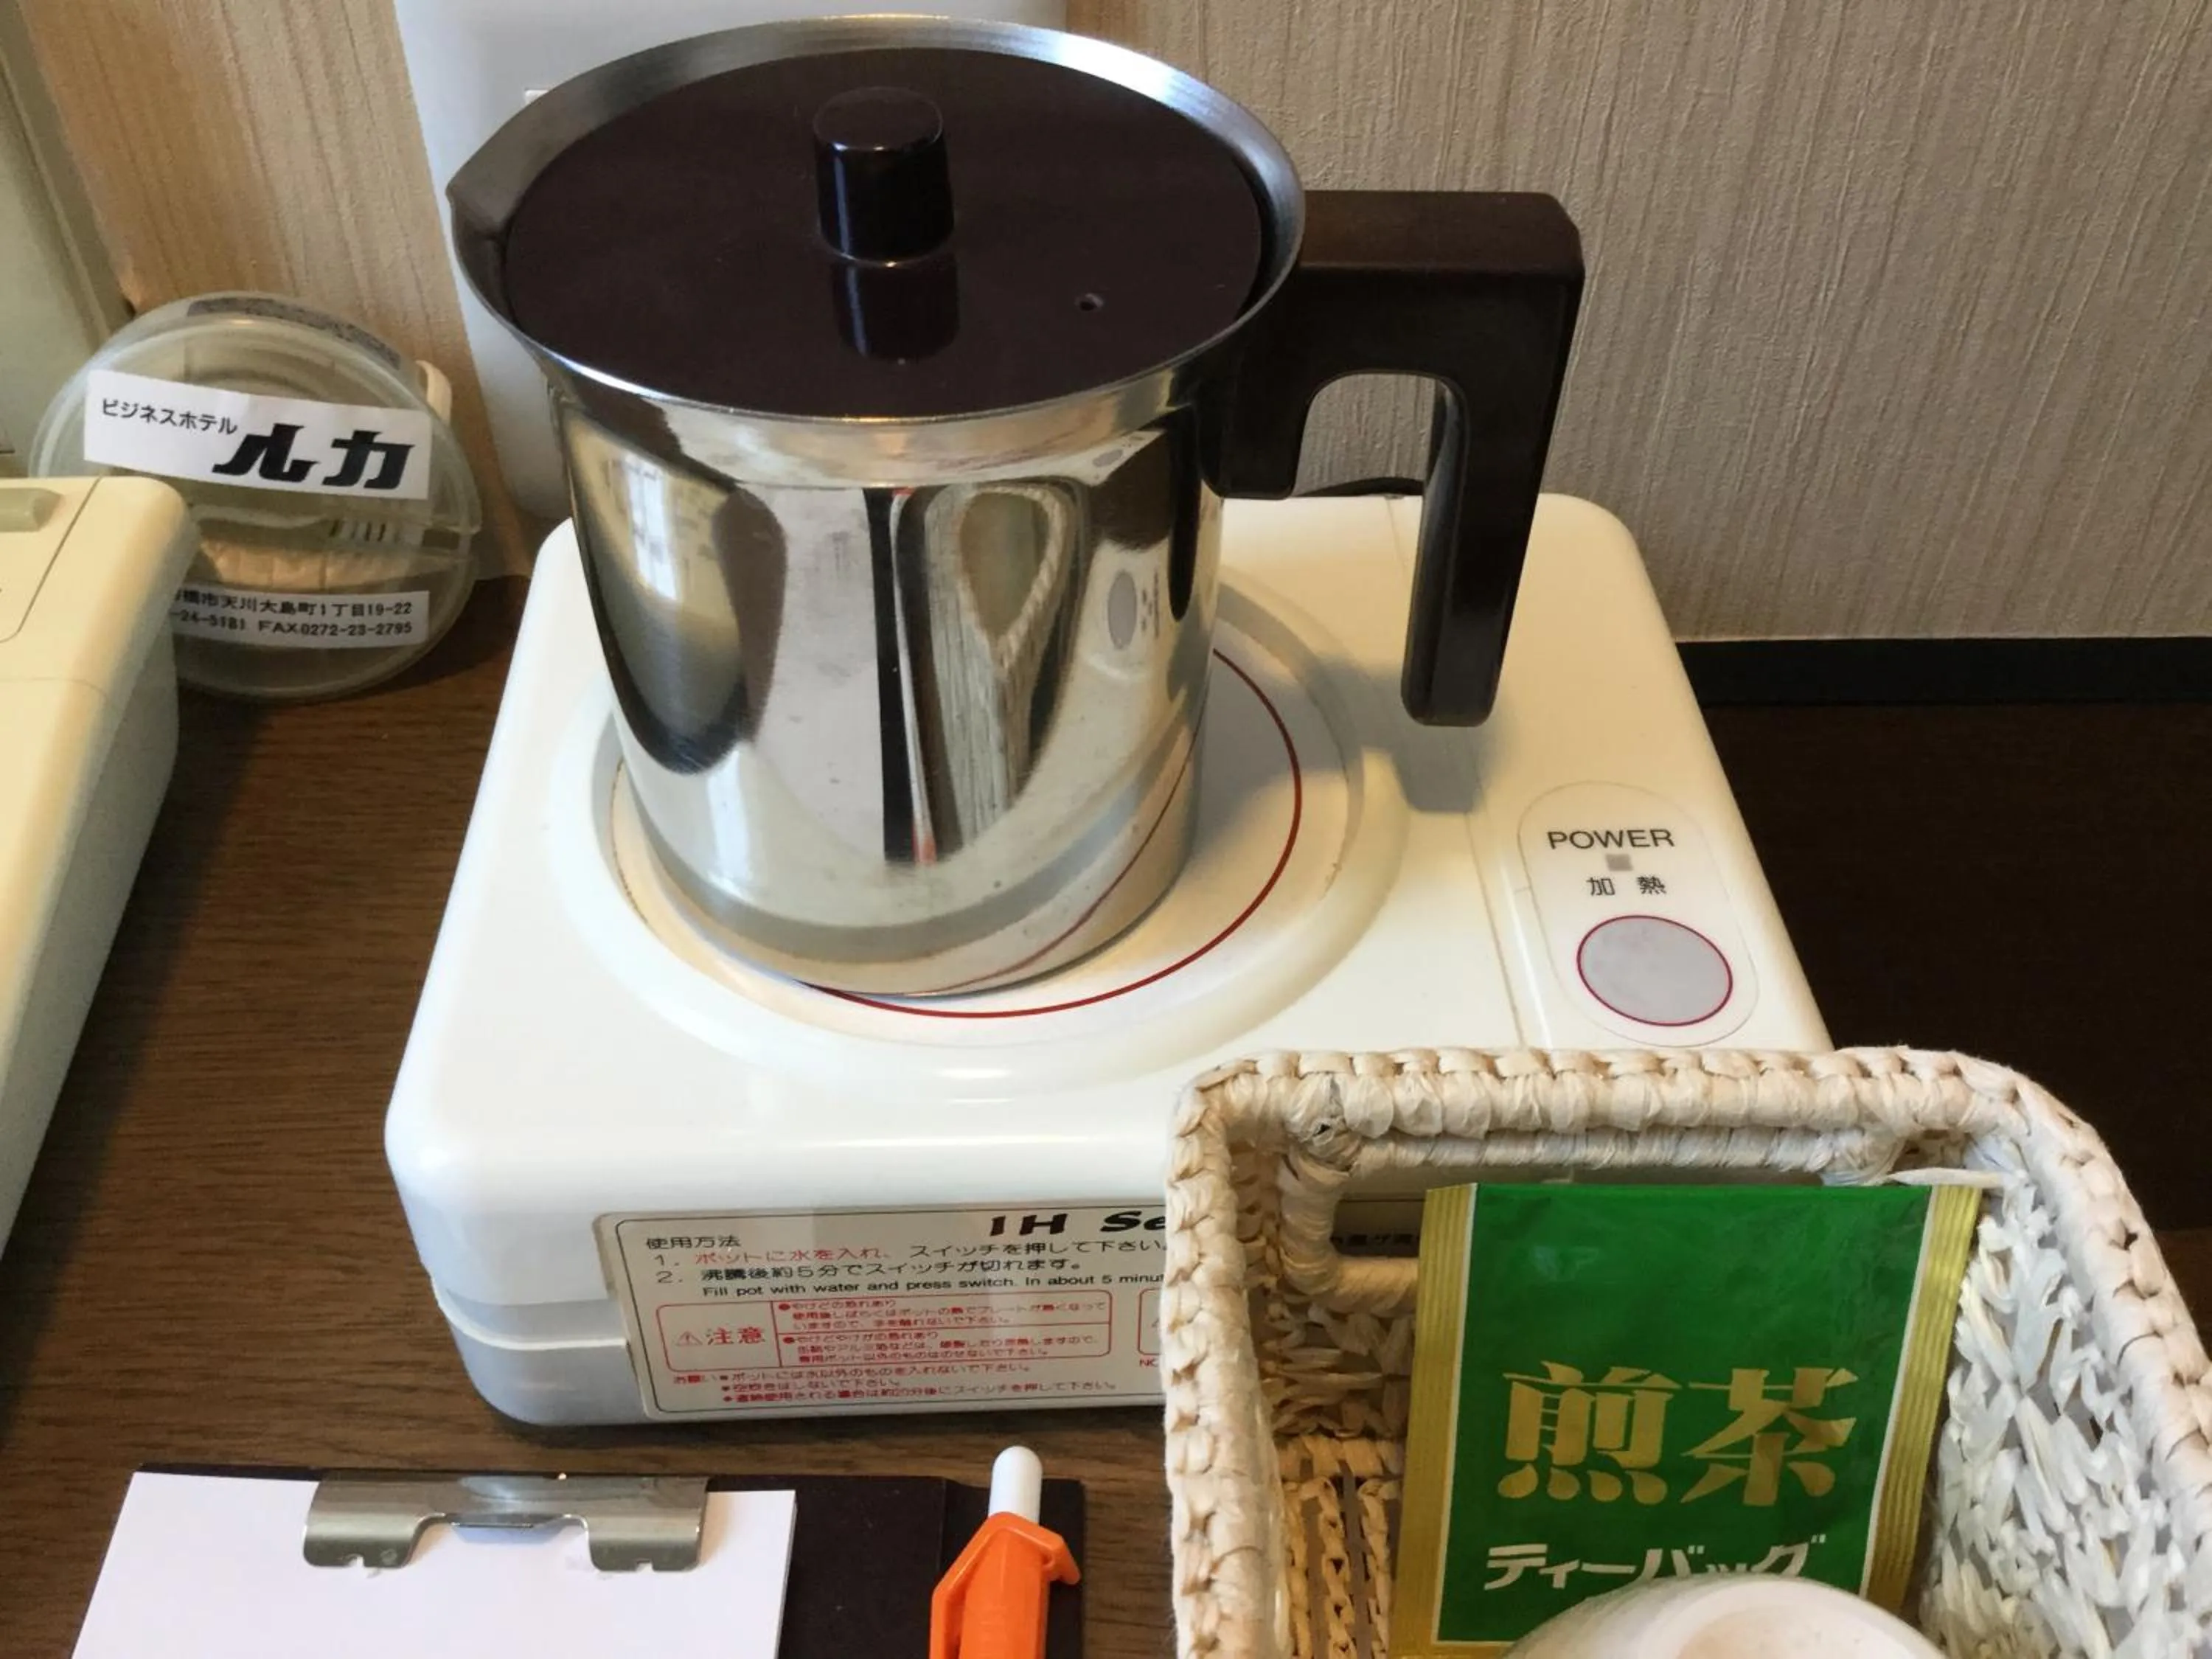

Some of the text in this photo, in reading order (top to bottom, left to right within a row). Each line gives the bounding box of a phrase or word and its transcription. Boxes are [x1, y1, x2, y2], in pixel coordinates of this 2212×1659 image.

[102, 399, 415, 490] ビジネスホテル ルカ
[175, 588, 412, 616] 橋市天川大島町1丁目19-22
[1546, 829, 1675, 849] POWER
[989, 1214, 1068, 1237] IH
[645, 1235, 741, 1250] 使用方法
[703, 1286, 728, 1297] Fill
[737, 1285, 763, 1297] pot
[771, 1283, 807, 1294] with
[813, 1282, 860, 1293] water
[867, 1281, 899, 1291] and
[906, 1280, 952, 1293] press
[1025, 1276, 1041, 1287] In
[1048, 1275, 1095, 1286] about
[1102, 1275, 1112, 1284] 5
[706, 1326, 766, 1346] 注意
[1497, 1361, 1860, 1506] 煎茶
